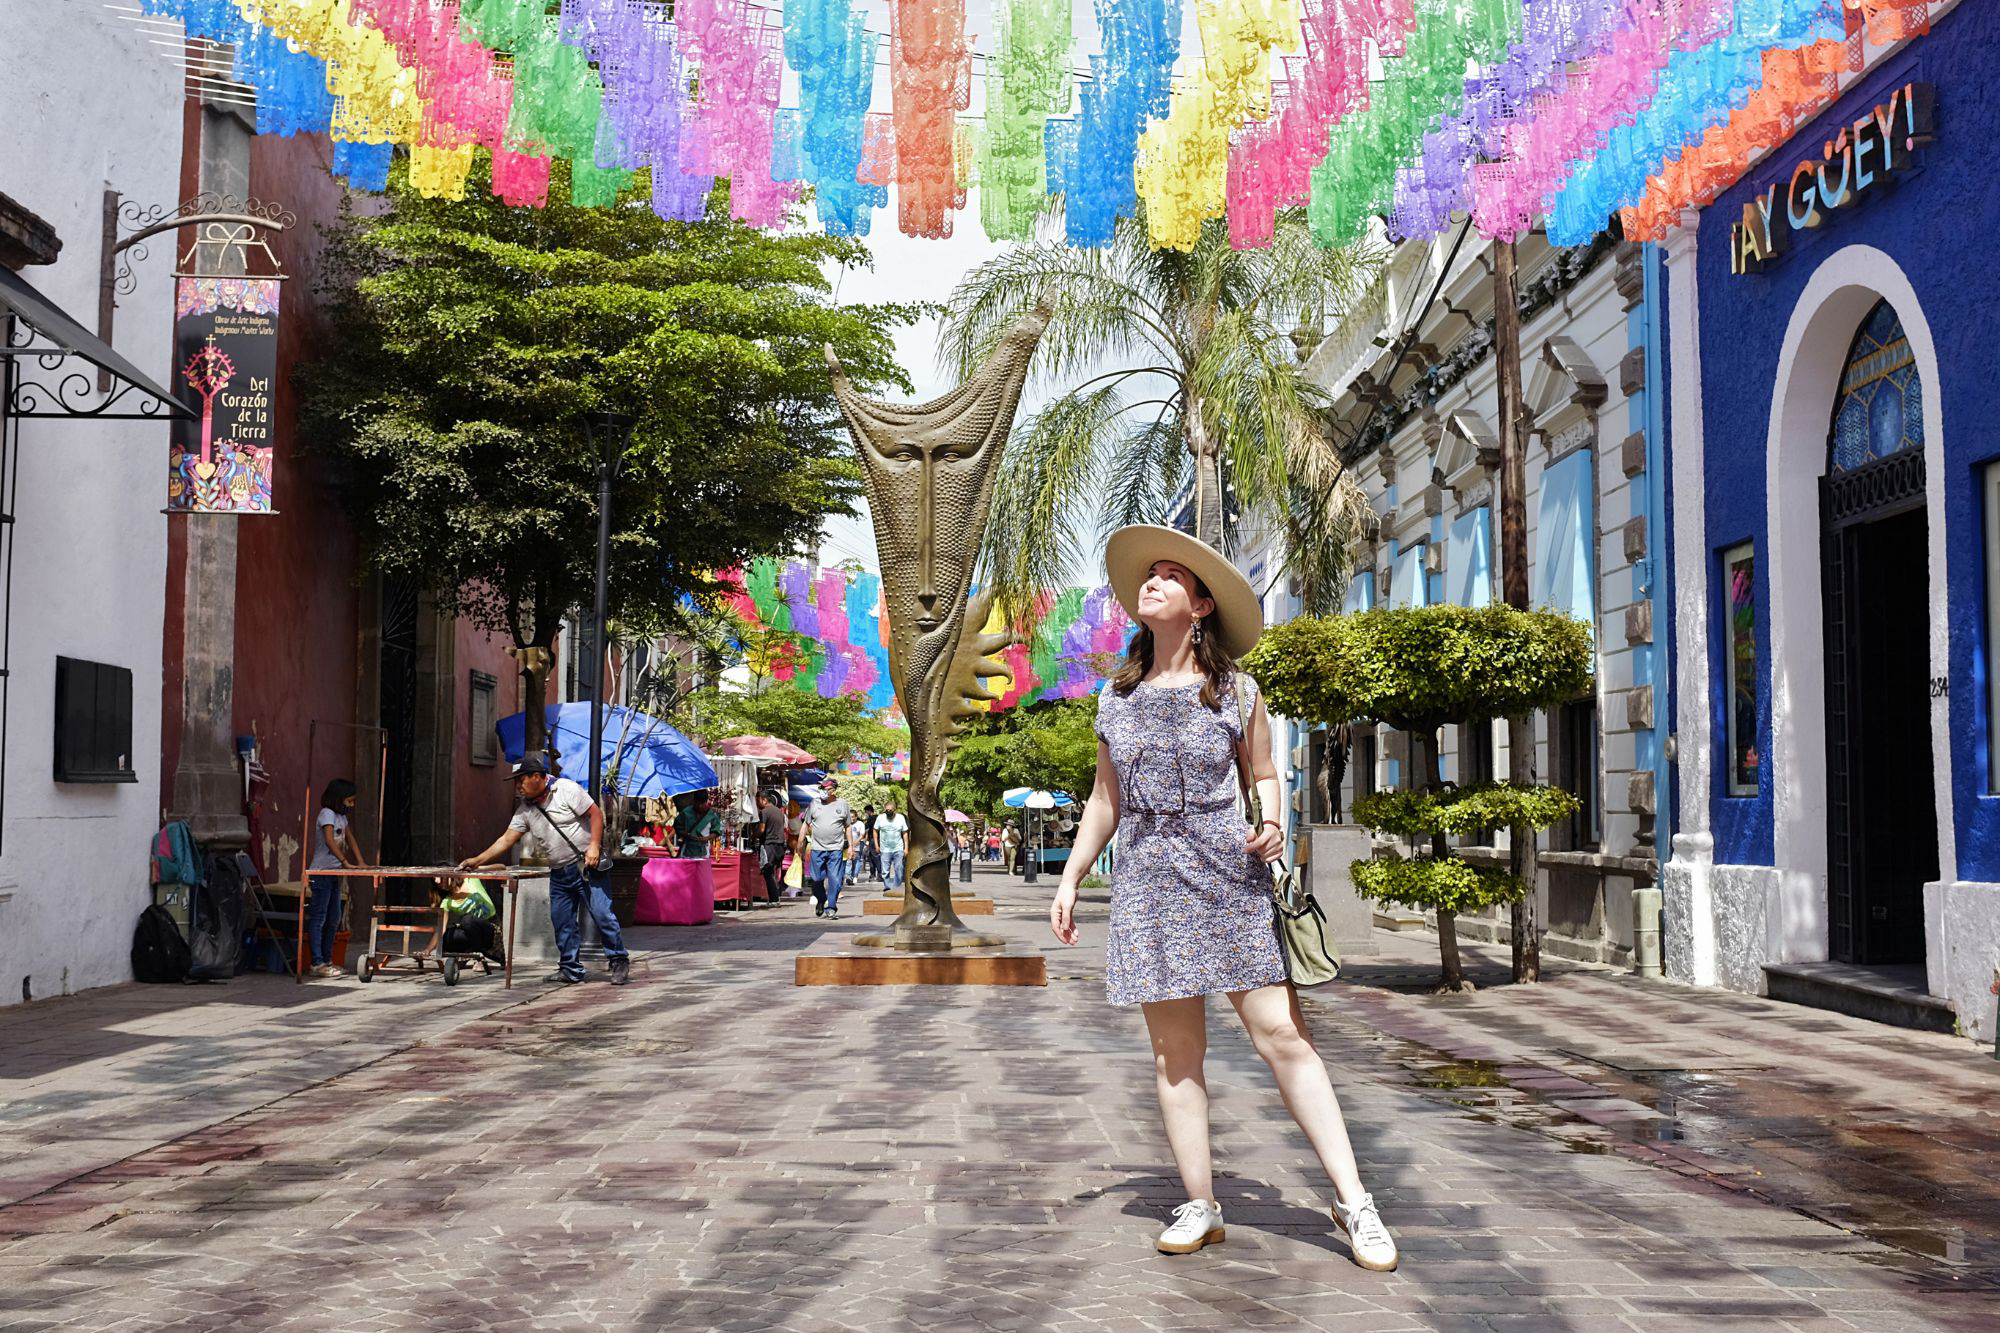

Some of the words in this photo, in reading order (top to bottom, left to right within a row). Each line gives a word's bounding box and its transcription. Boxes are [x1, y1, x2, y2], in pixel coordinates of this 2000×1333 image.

[1787, 82, 1915, 230] GÜEY!
[250, 376, 268, 391] Del
[221, 392, 268, 408] Corazón
[237, 408, 252, 423] de
[256, 408, 267, 423] la
[231, 423, 266, 439] Tierra
